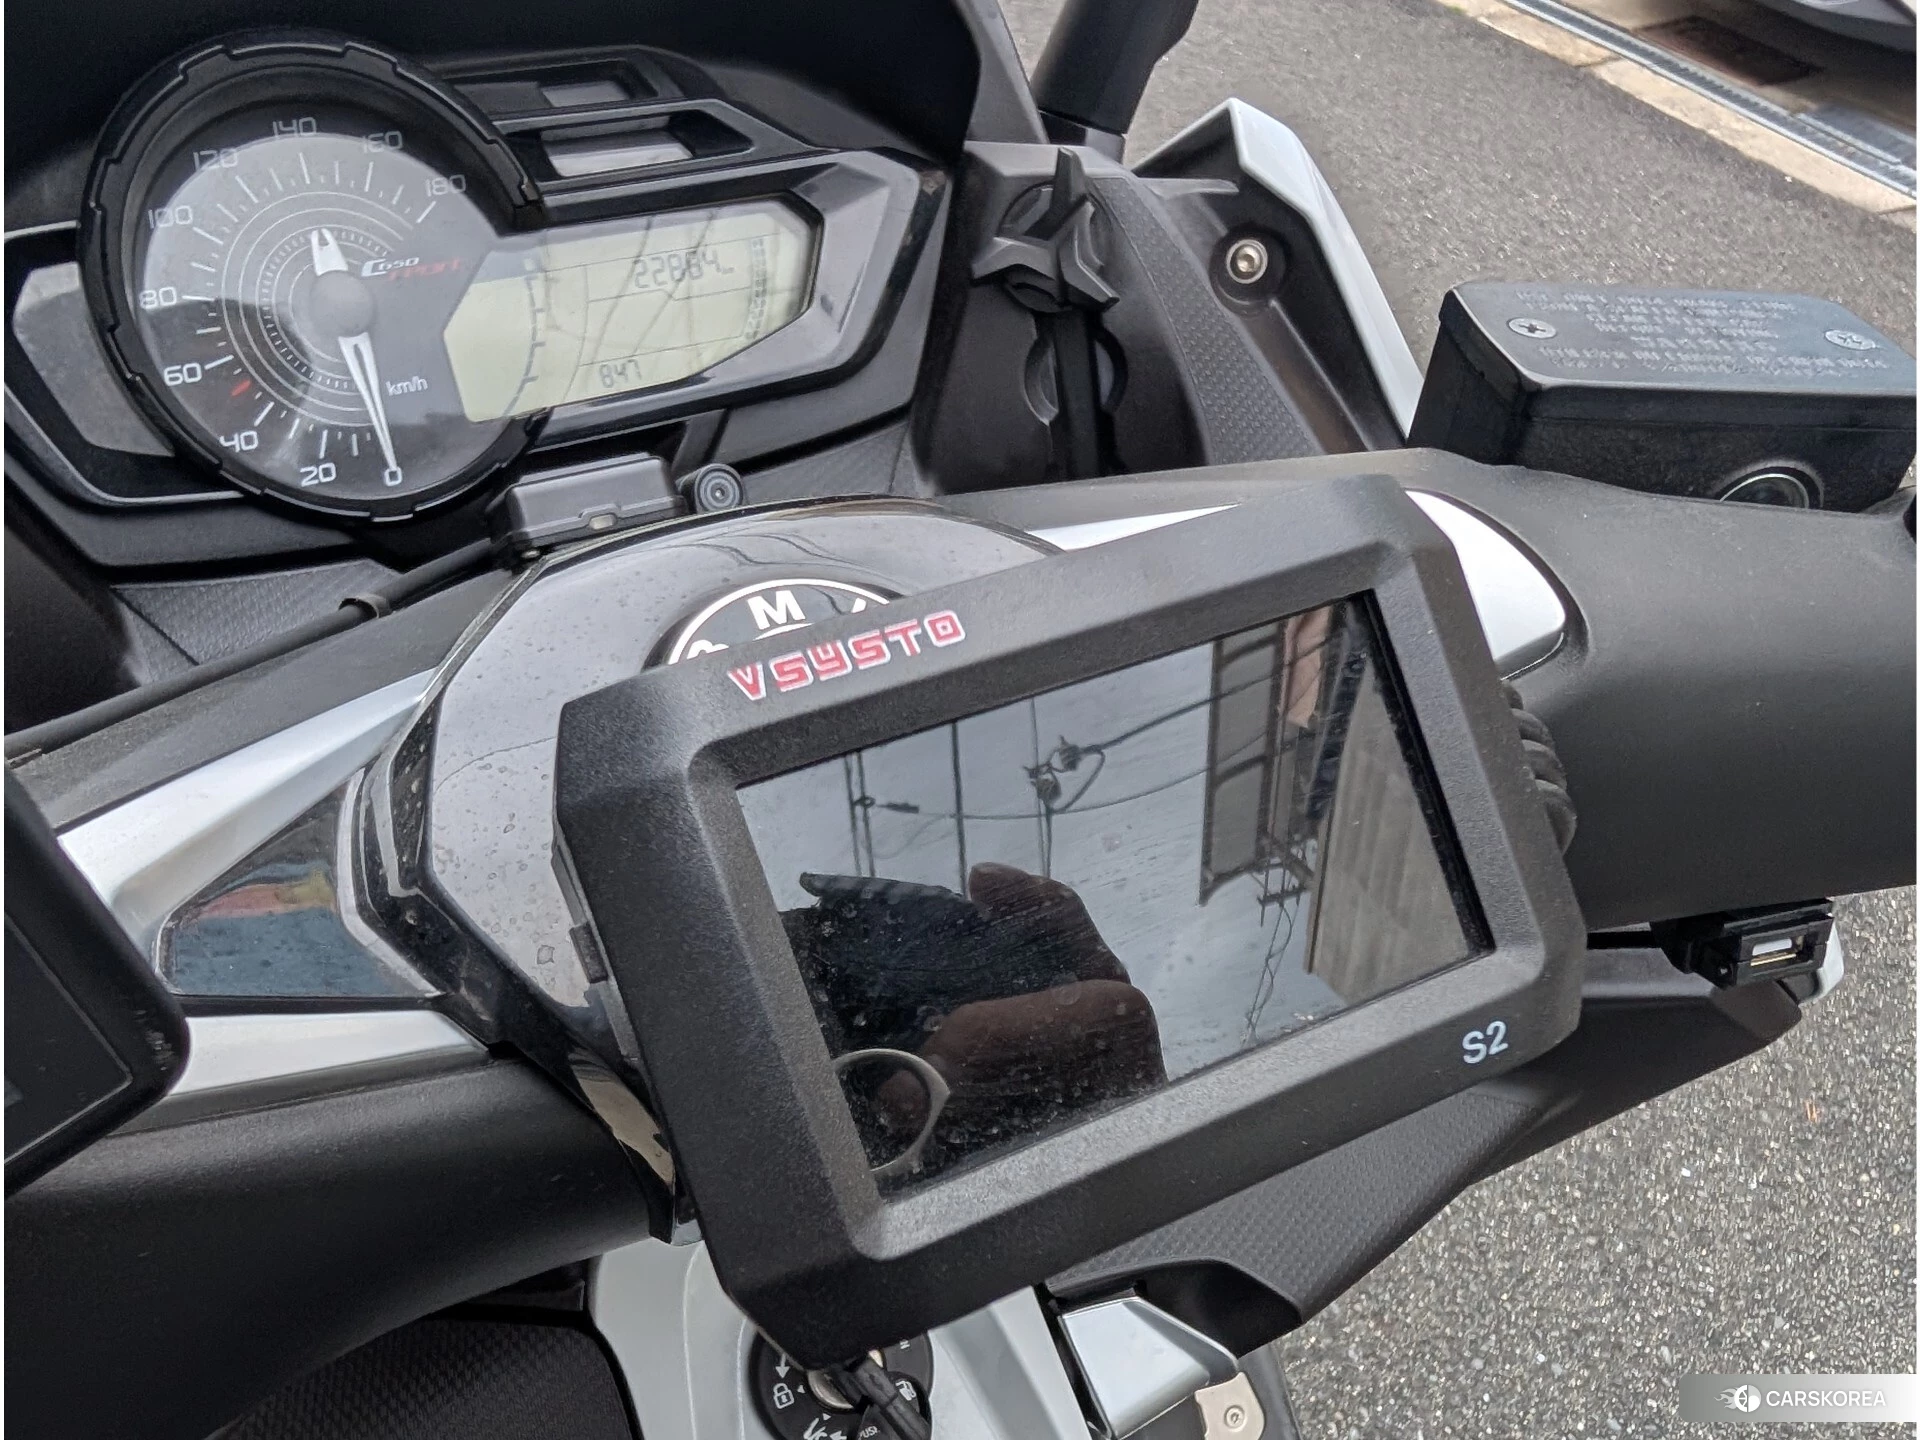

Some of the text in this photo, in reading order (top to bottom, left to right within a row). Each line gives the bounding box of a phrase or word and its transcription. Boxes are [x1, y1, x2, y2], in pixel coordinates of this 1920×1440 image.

[273, 117, 317, 137] 140
[364, 131, 403, 151] 160
[193, 148, 238, 171] 120
[426, 174, 467, 196] 180
[148, 205, 194, 228] 100
[361, 257, 420, 277] C650
[140, 286, 177, 307] 80
[164, 363, 203, 386] 60
[600, 359, 643, 389] 847
[385, 376, 428, 396] km/h
[220, 430, 258, 453] 40
[300, 462, 337, 487] 20
[384, 467, 403, 487] 0
[726, 609, 966, 701] VSYSTO
[1462, 1021, 1509, 1064] S2
